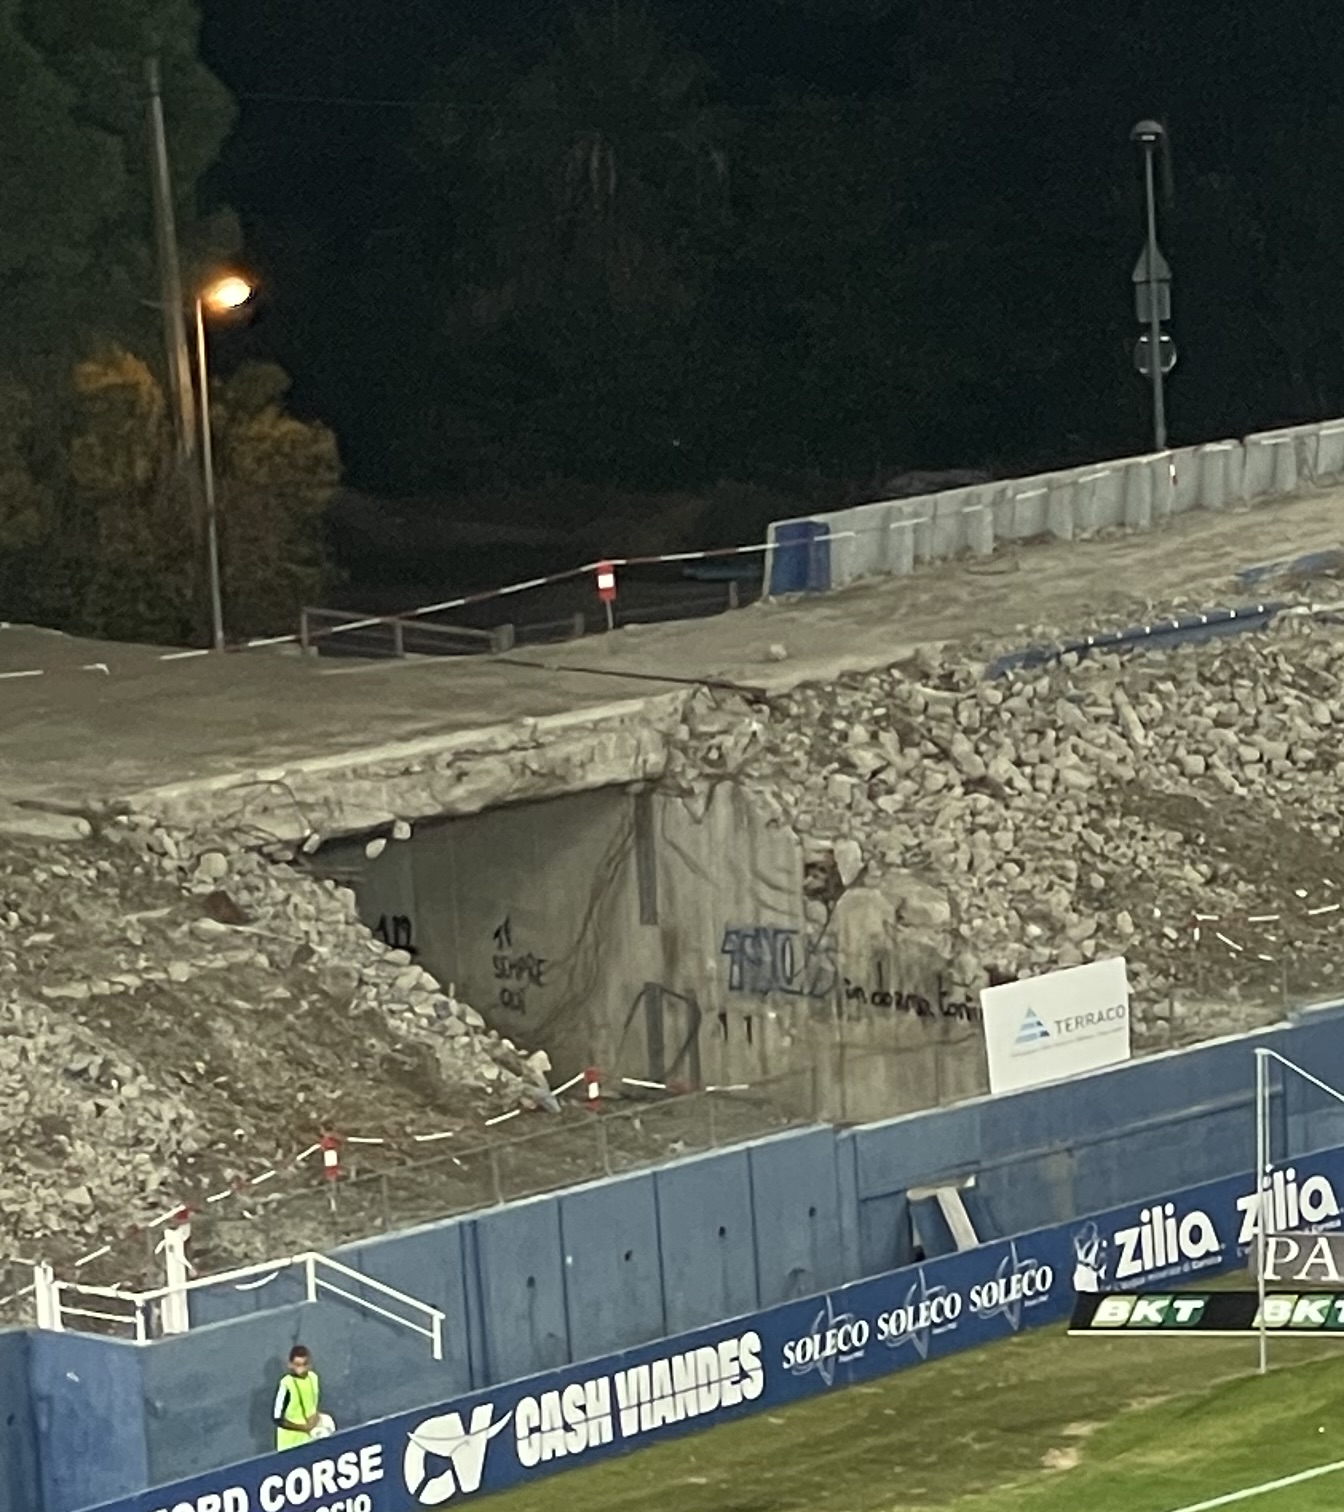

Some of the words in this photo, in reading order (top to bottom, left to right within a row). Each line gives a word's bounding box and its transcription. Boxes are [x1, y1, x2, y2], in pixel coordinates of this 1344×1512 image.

[1054, 1004, 1126, 1035] TERRACO
[1114, 1202, 1222, 1278] zilia
[969, 1265, 1053, 1313] SOLECO
[1094, 1296, 1207, 1327] BKT
[877, 1293, 961, 1341] SOLECO
[783, 1320, 869, 1369] SOLECO
[515, 1375, 614, 1468] CASH
[615, 1331, 765, 1438] VIANDES
[259, 1444, 384, 1512] CORSE
